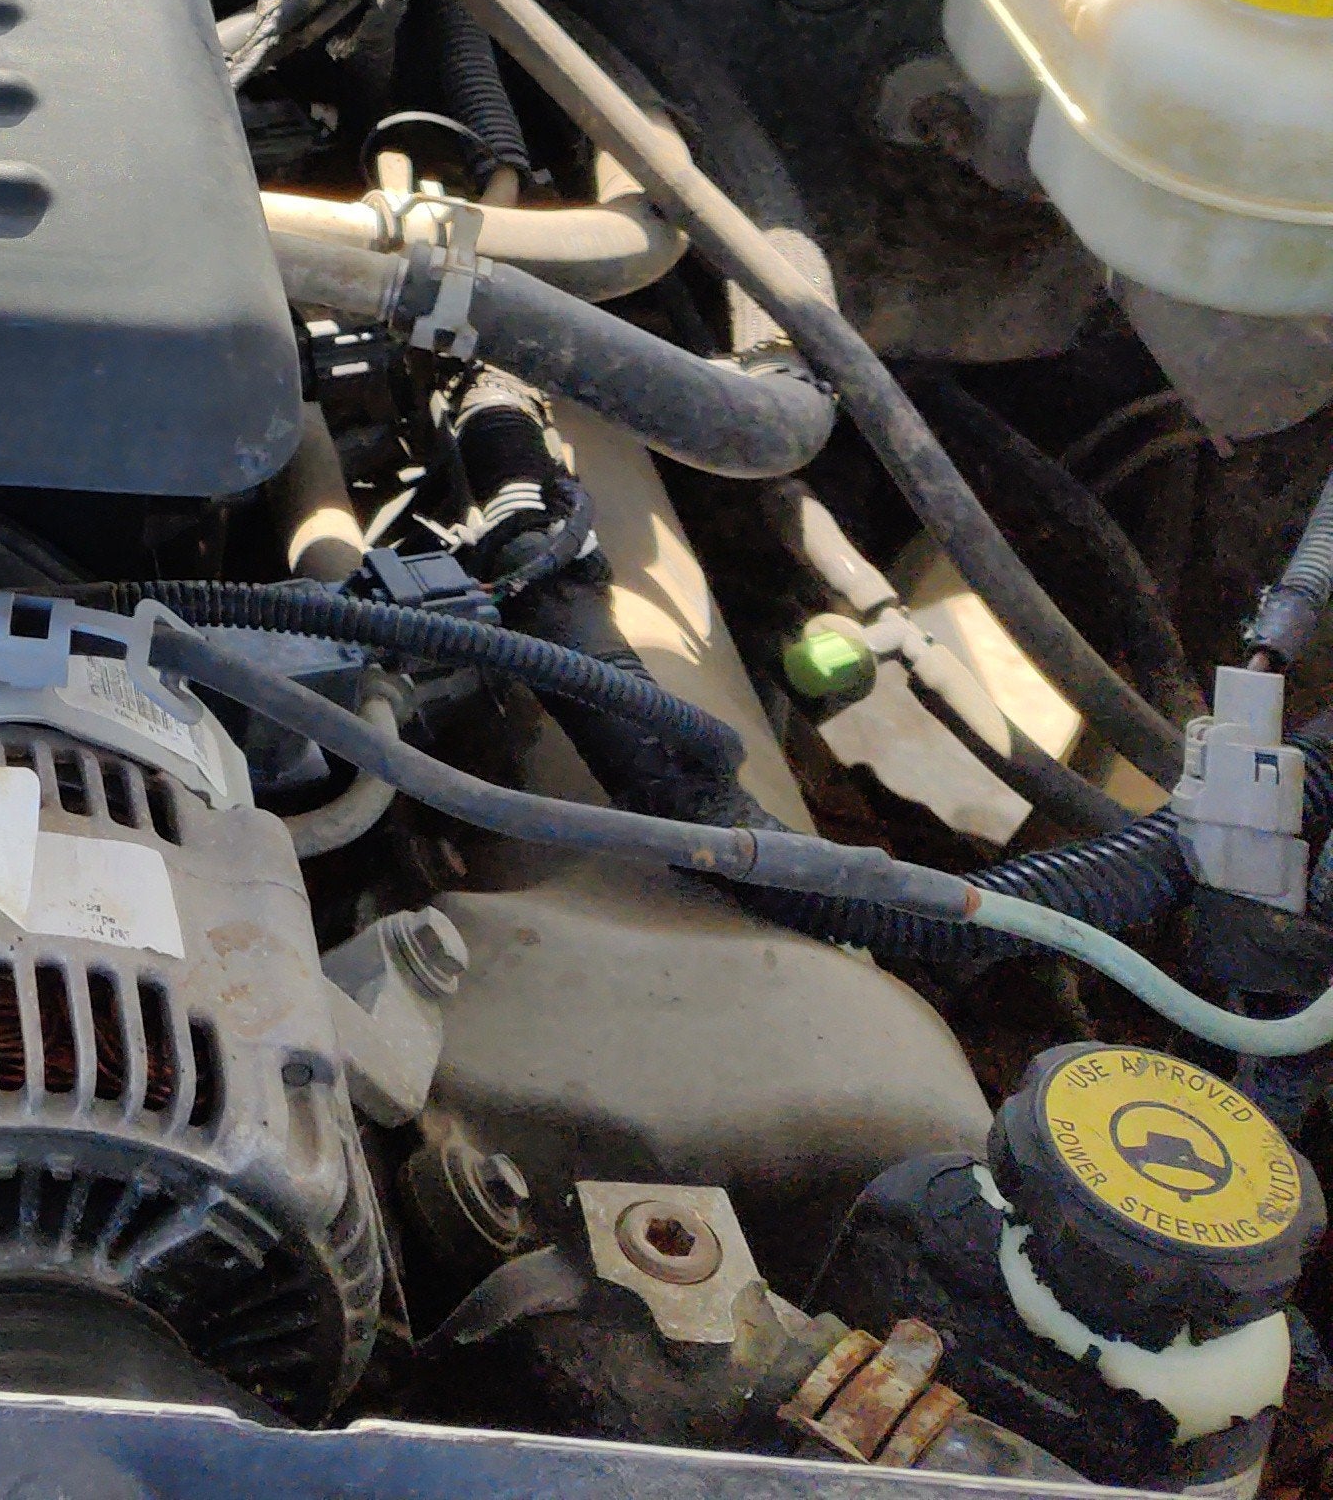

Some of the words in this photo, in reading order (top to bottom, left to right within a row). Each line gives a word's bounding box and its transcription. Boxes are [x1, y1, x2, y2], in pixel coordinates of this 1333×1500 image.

[1065, 1059, 1110, 1089] USE
[1121, 1054, 1254, 1123] APPROVED
[1051, 1117, 1108, 1187] POWER
[1119, 1196, 1260, 1244] STEERING
